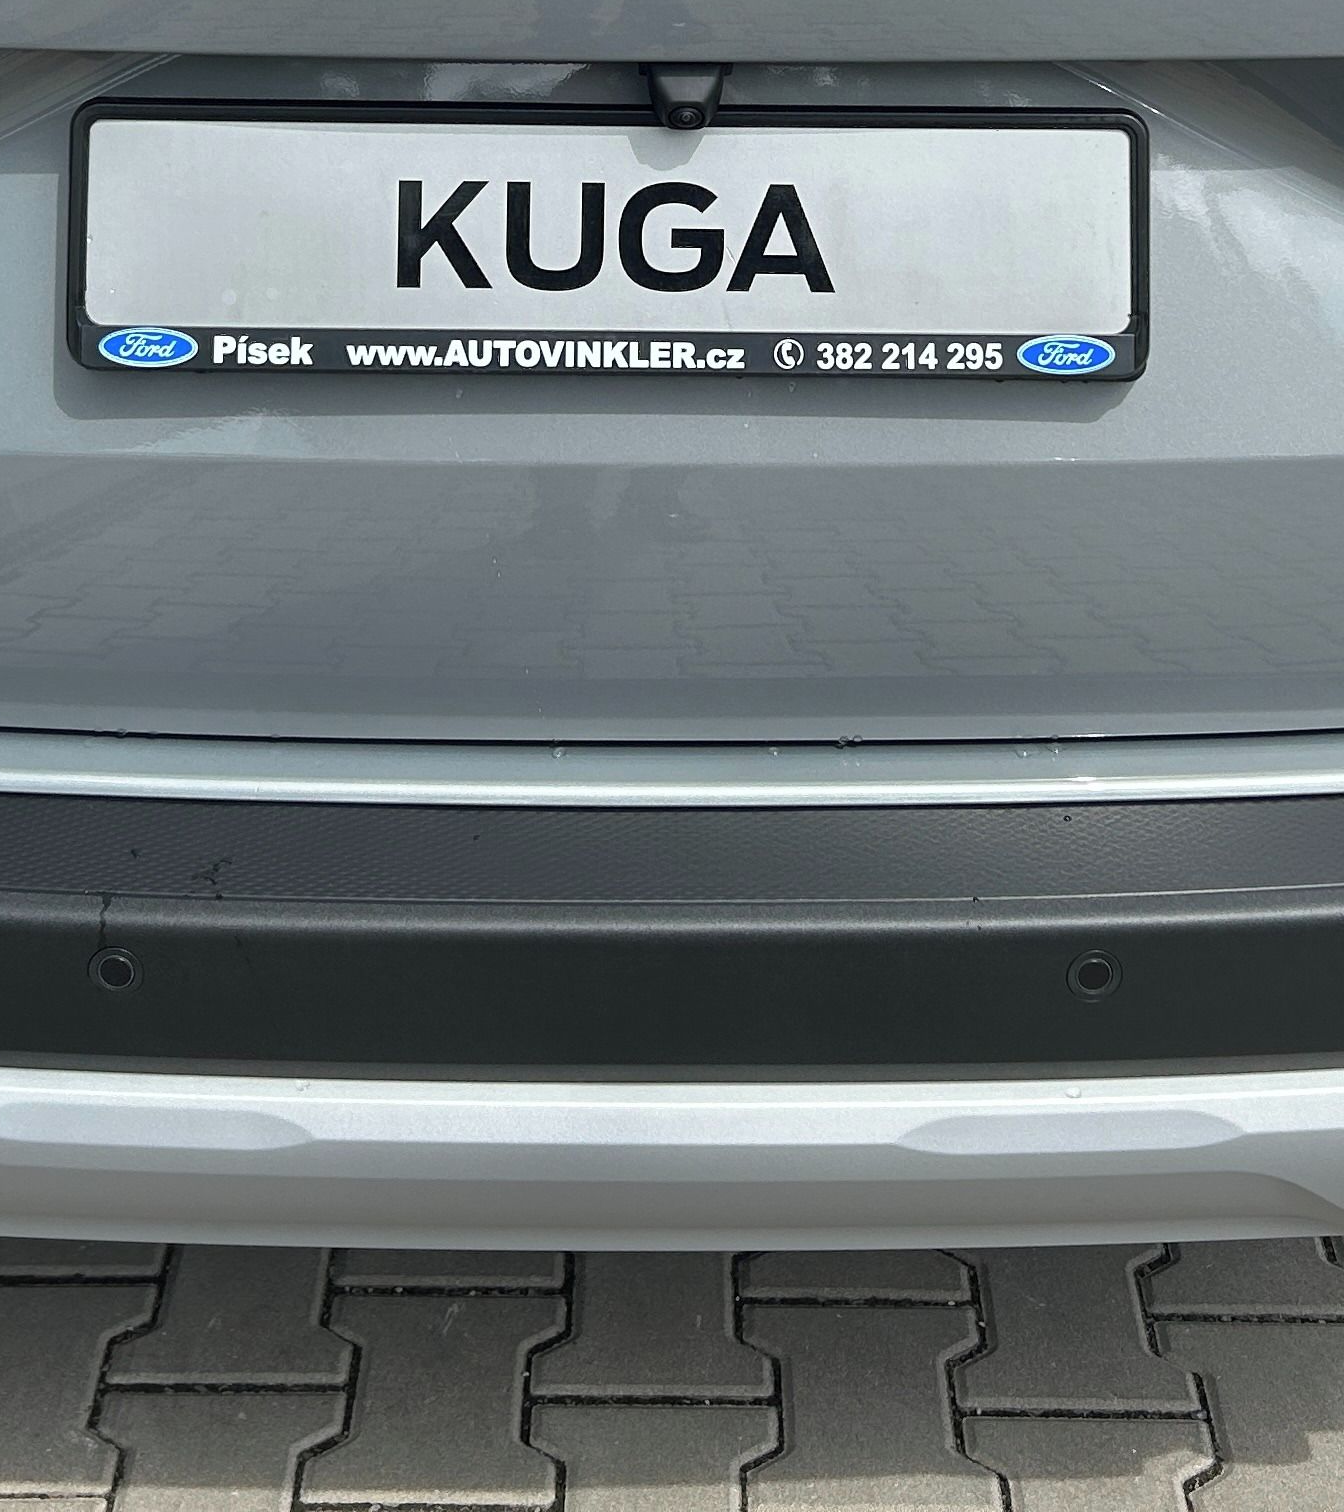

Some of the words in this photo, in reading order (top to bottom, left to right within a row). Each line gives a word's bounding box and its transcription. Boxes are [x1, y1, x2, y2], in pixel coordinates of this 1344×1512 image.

[397, 180, 836, 293] KUGA
[119, 333, 178, 358] Ford
[213, 335, 314, 365] Písek
[346, 339, 746, 370] www.AUTOVINKLER.cz
[816, 342, 873, 370] 382
[881, 342, 939, 370] 214
[946, 342, 1004, 370] 295
[1037, 341, 1094, 367] Ford
